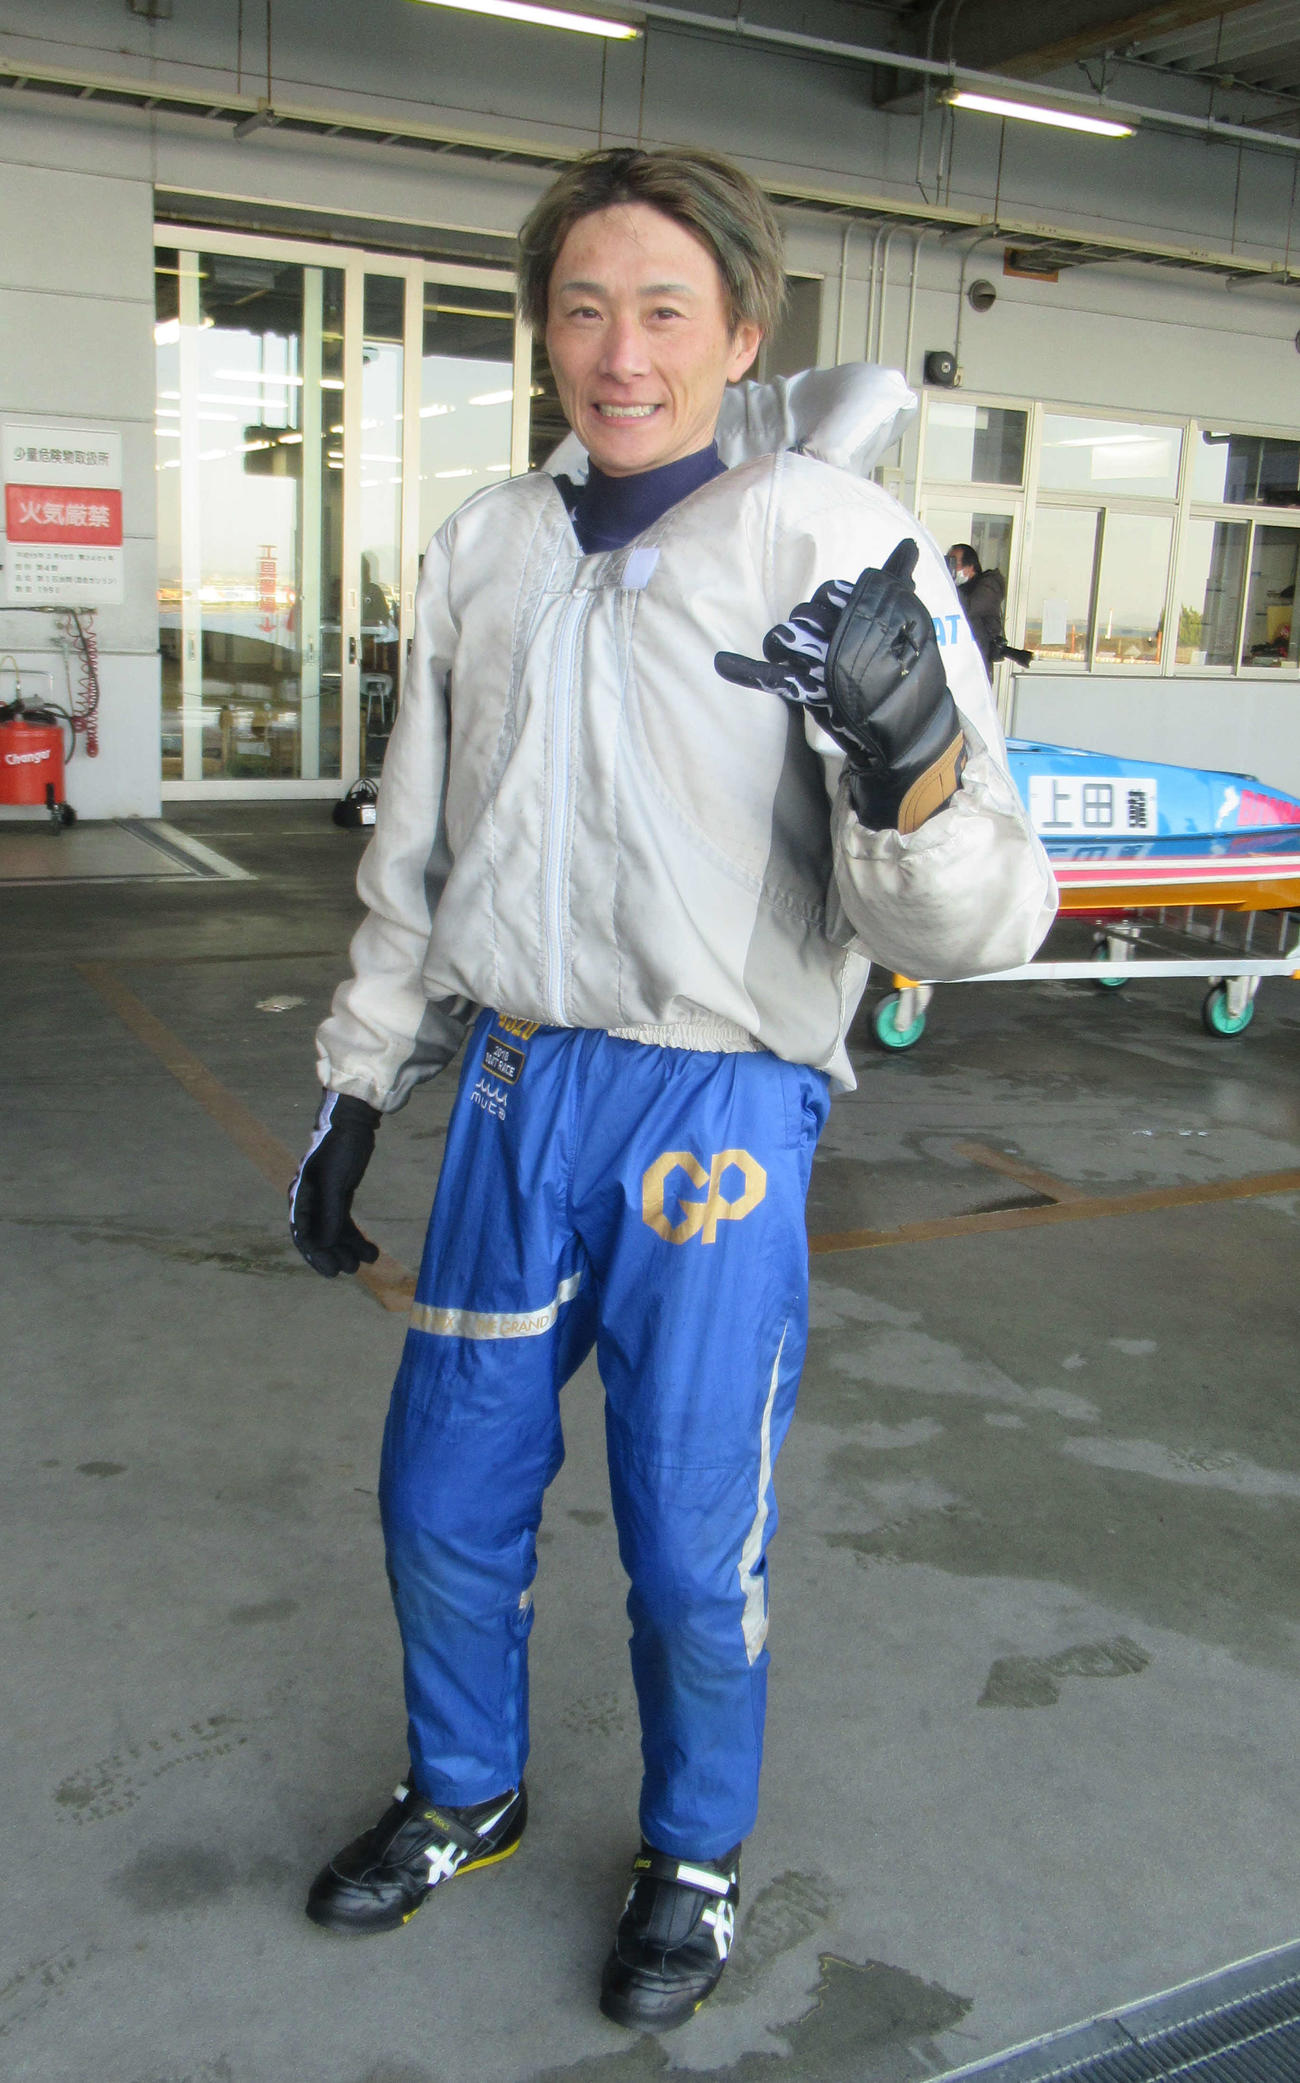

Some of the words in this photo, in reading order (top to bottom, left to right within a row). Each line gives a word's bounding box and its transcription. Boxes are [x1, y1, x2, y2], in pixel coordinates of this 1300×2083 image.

[19, 501, 111, 528] 火気厳禁
[642, 1149, 767, 1245] GP
[500, 1315, 549, 1334] GRAND
